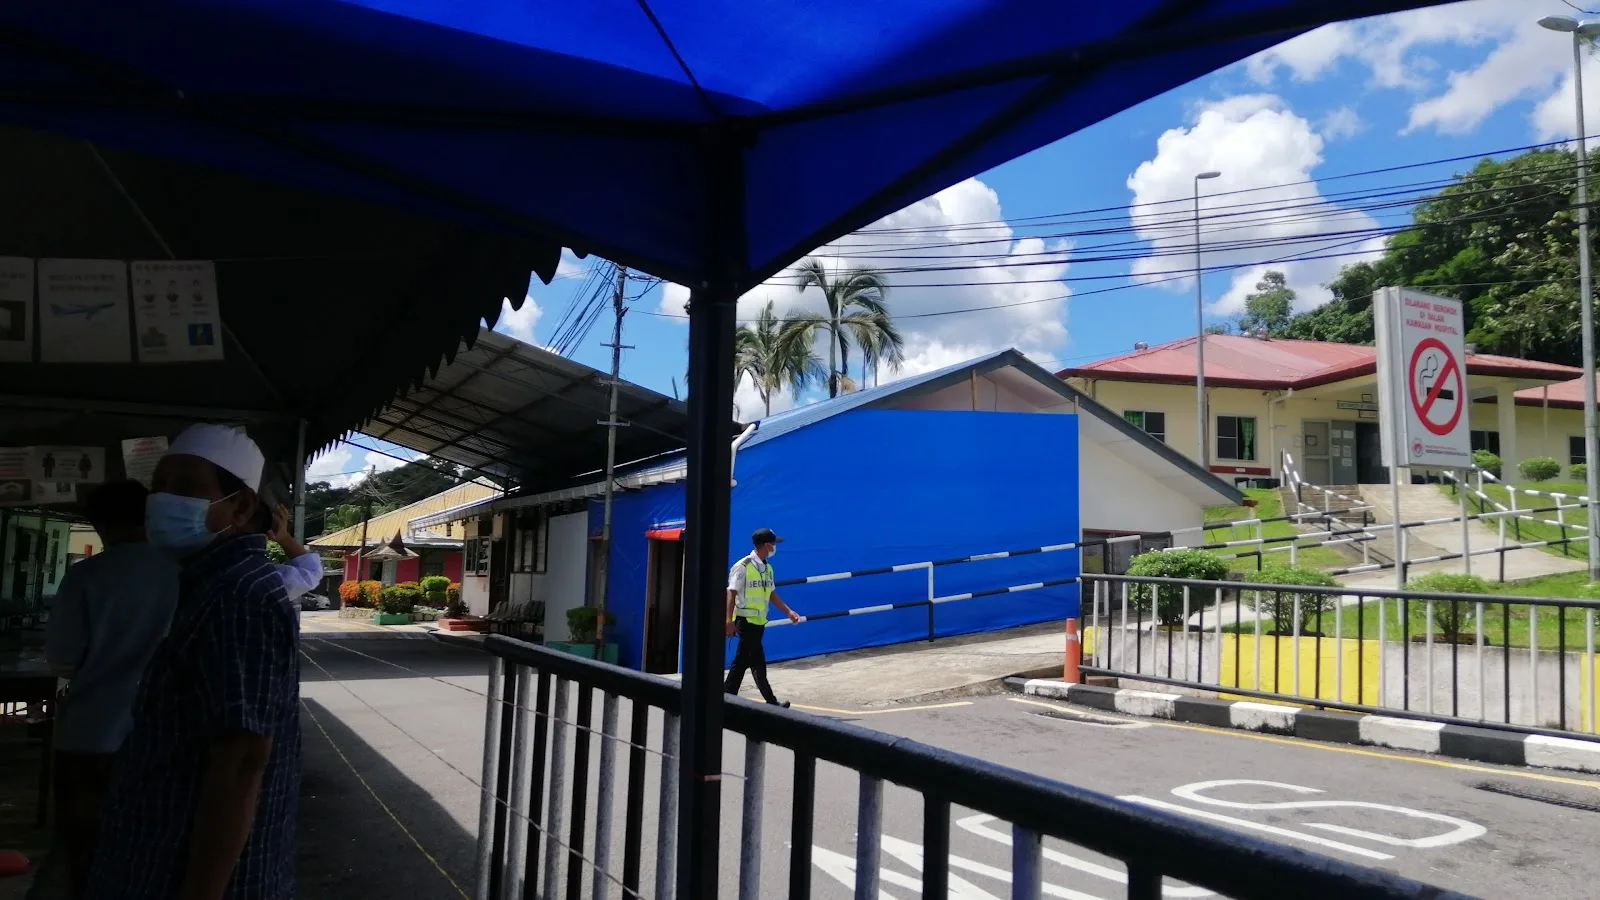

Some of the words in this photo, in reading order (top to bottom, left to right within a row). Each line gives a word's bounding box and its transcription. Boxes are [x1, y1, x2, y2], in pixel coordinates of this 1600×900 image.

[1404, 298, 1431, 309] DILARANG
[1433, 304, 1456, 315] MEROKOK
[1428, 313, 1444, 322] DALAM
[1406, 319, 1431, 329] KAWASAN
[1434, 324, 1458, 335] HOSPITAL
